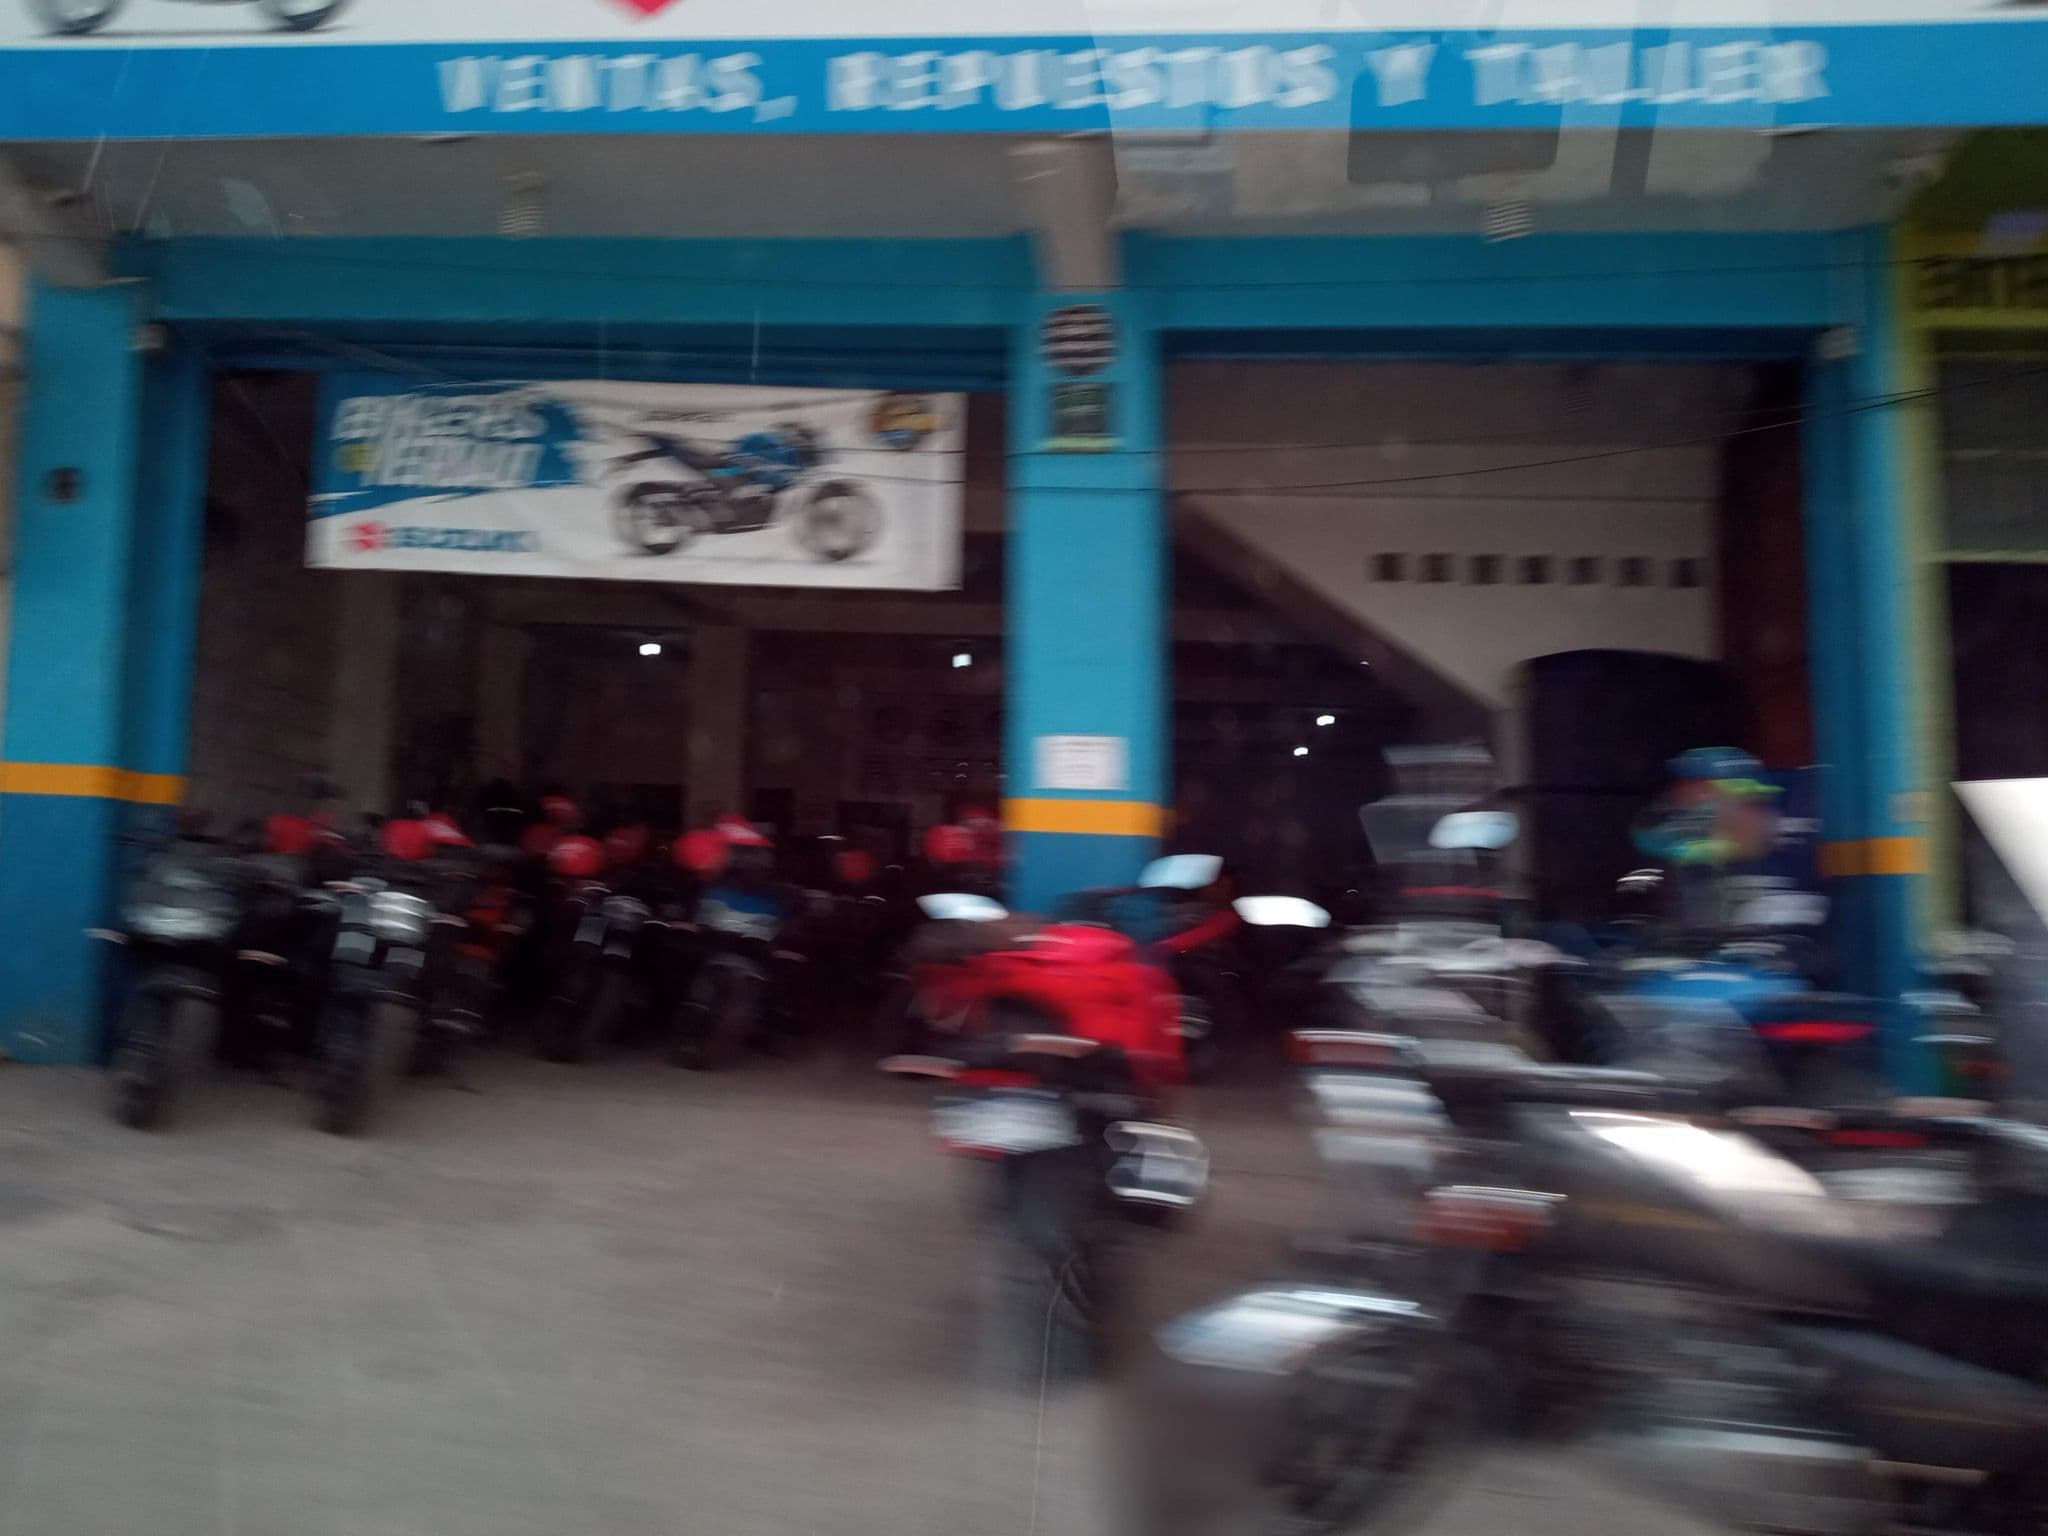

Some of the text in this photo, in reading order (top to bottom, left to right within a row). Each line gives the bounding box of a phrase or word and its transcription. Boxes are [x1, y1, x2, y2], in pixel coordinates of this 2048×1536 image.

[438, 41, 1829, 122] VENTAS, REPUESTOS Y TALLER
